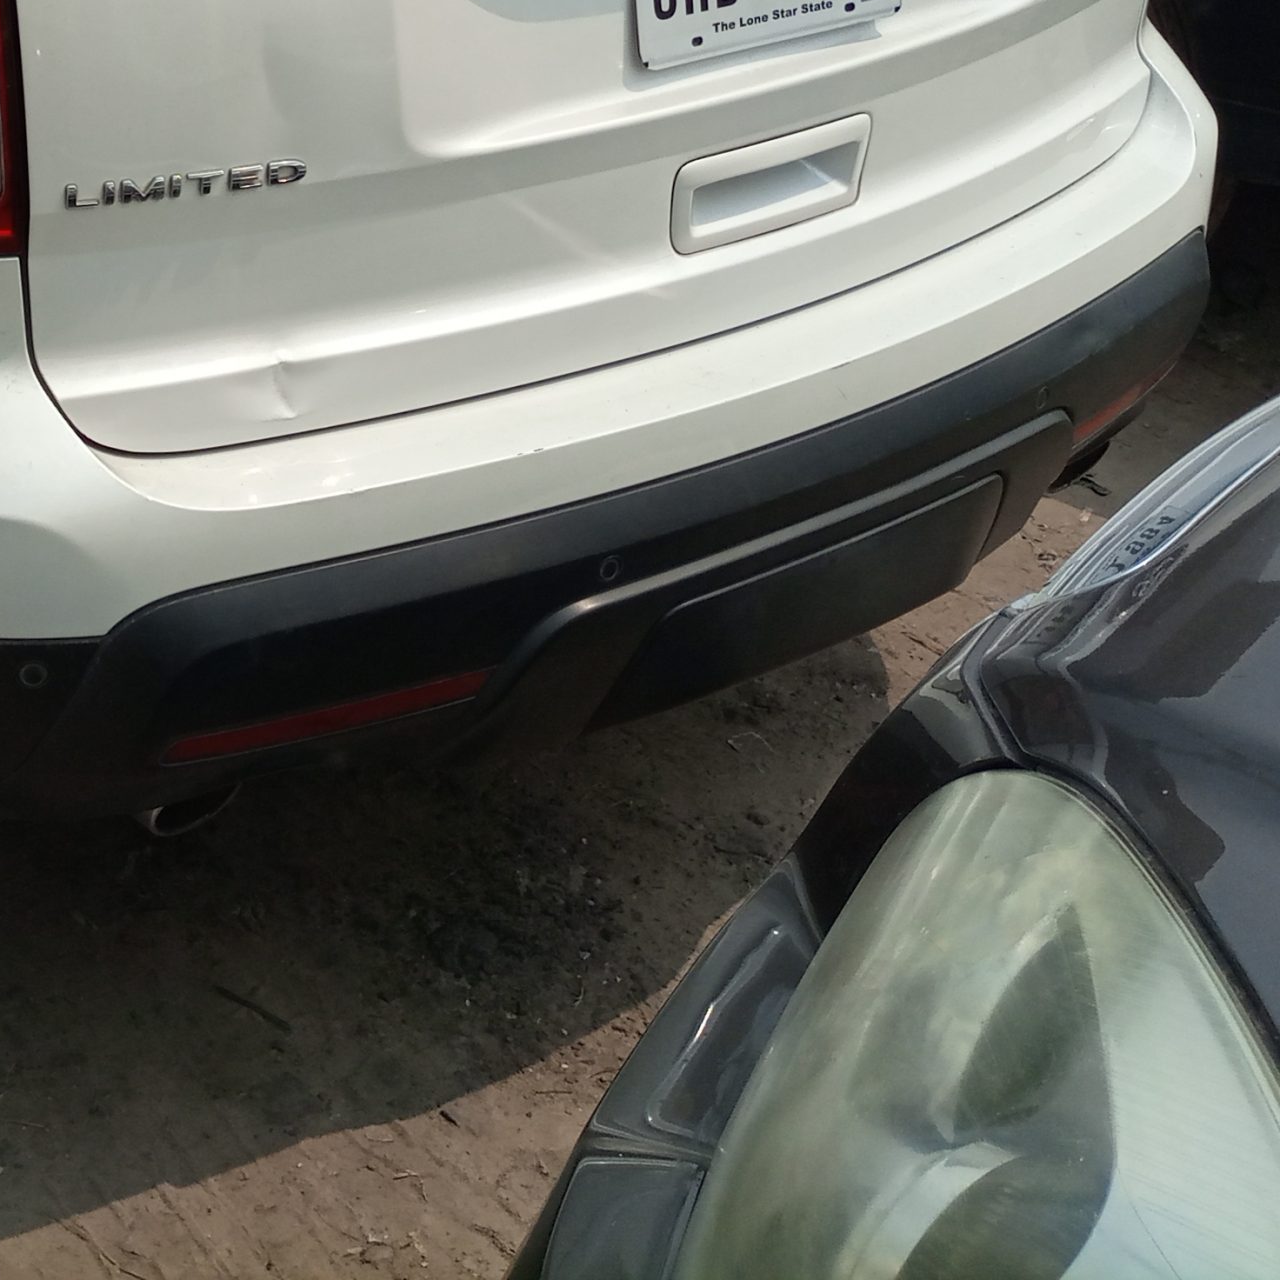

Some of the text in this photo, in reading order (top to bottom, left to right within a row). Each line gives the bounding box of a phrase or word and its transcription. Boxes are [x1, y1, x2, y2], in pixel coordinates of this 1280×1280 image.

[712, 0, 833, 34] The Lone Star State
[64, 158, 307, 211] LIMITED
